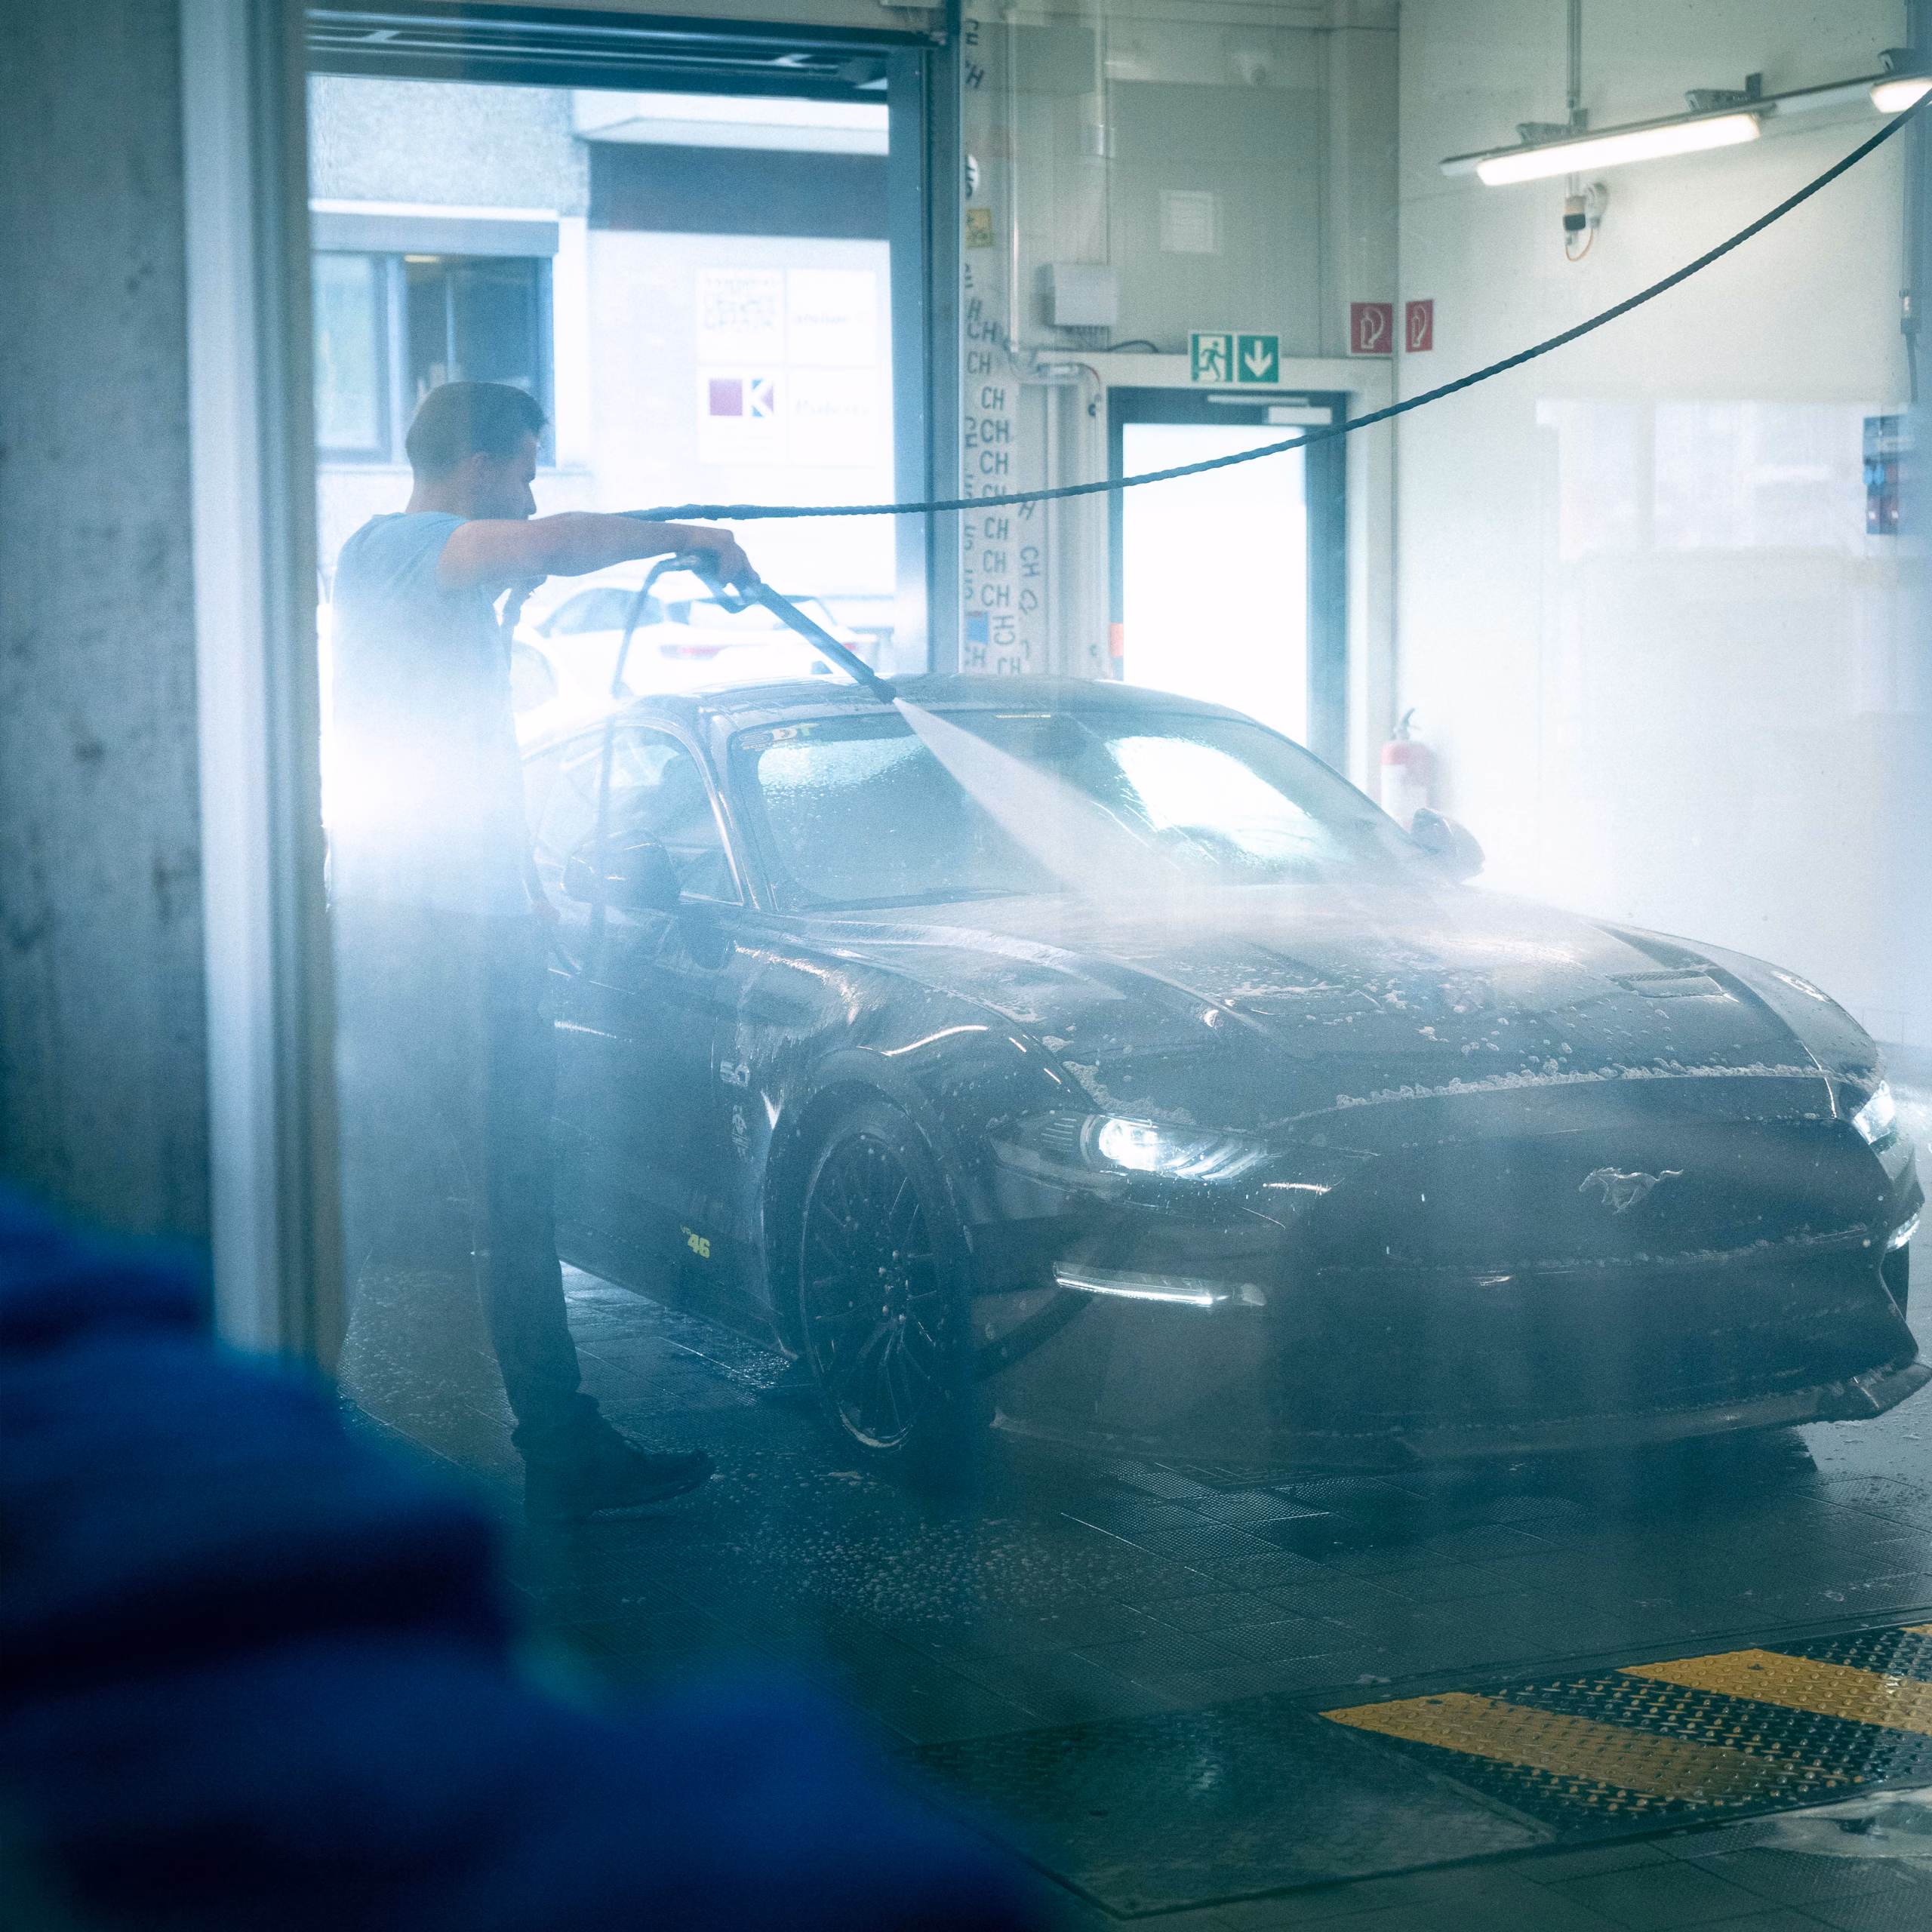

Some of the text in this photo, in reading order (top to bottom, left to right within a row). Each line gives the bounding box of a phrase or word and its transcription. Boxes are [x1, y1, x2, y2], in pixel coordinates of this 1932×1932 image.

[967, 351, 992, 376] CH
[982, 386, 1004, 411] CH
[981, 419, 1009, 444] CH
[980, 451, 1009, 475] CH
[984, 516, 1008, 540] CH
[983, 549, 1008, 574] CH
[1020, 546, 1040, 577] CH
[982, 584, 1010, 608] CH
[992, 614, 1016, 646] CH
